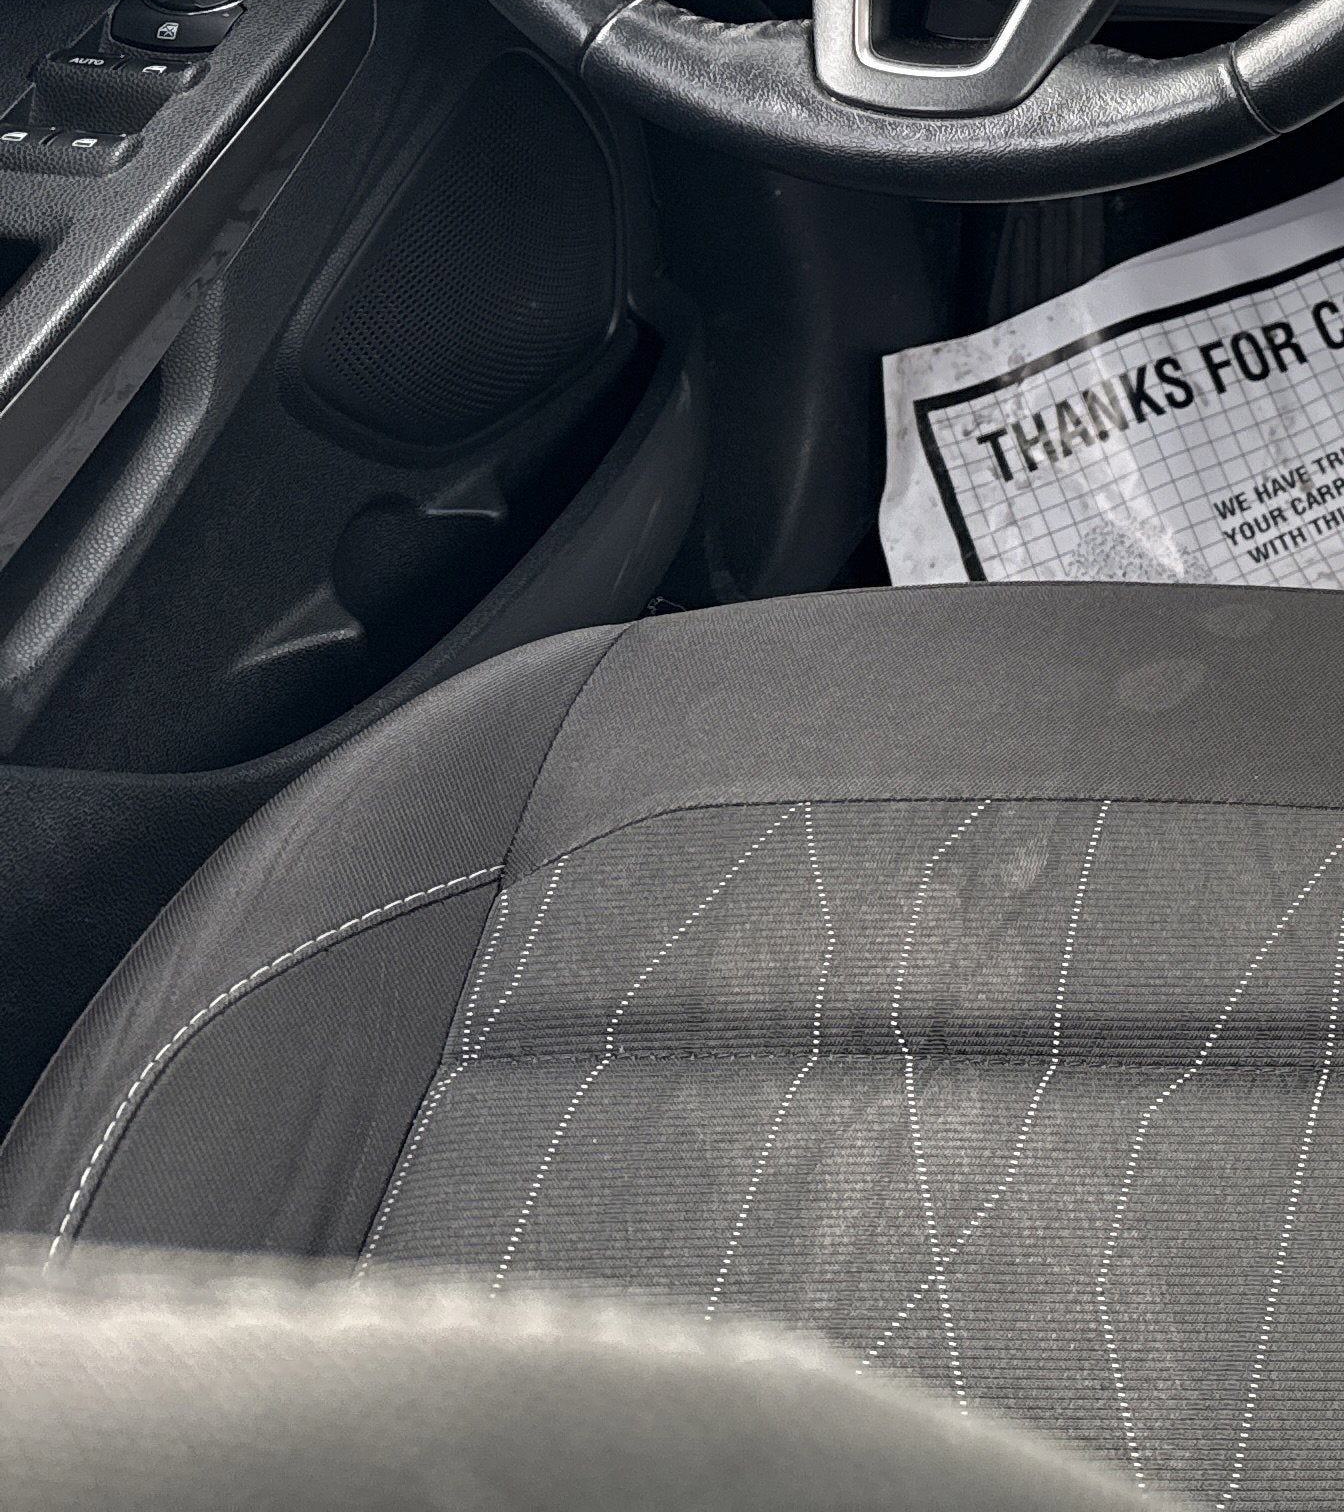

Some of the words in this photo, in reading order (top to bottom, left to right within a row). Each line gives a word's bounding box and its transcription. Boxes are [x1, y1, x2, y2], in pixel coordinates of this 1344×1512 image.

[975, 356, 1194, 484] THANKS
[1203, 321, 1310, 396] FOR
[1214, 496, 1247, 522] WE
[1253, 468, 1310, 508] HAVE
[1224, 505, 1286, 549] YOUR
[1246, 523, 1304, 564] WITH
